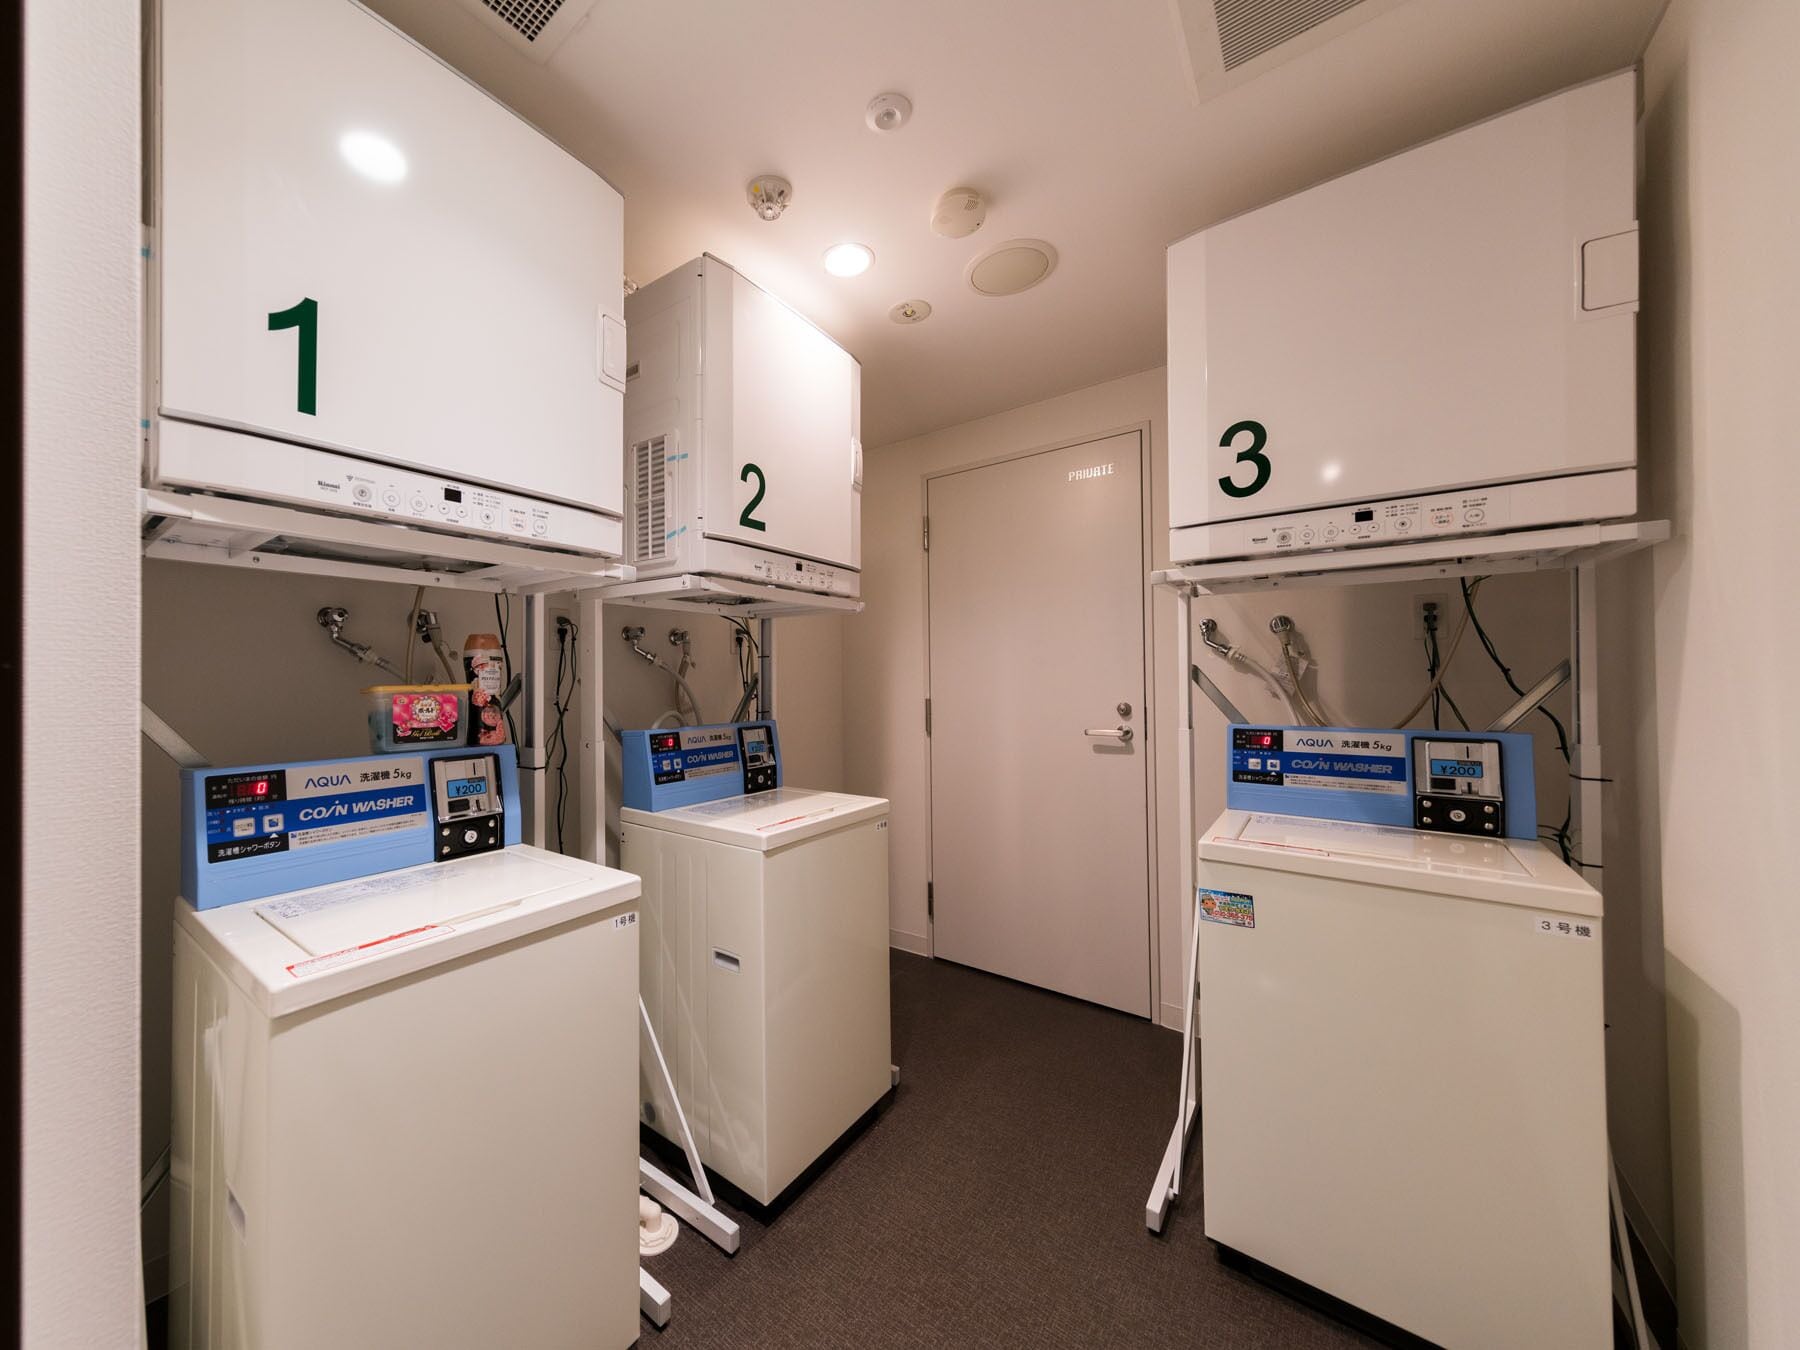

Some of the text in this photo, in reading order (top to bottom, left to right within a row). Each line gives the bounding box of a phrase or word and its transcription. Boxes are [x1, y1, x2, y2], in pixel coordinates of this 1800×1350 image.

[268, 297, 318, 417] 1
[1218, 420, 1272, 498] 3
[1068, 463, 1115, 482] PRIVATE
[739, 463, 766, 532] 2
[668, 738, 674, 747] 0
[688, 736, 706, 744] AQUA
[1263, 736, 1271, 745] 0
[1296, 738, 1392, 751] AQUA 洗濯機 5kg
[707, 750, 734, 760] WASHER
[1291, 758, 1393, 774] COIN WASHER
[1440, 765, 1476, 776] ¥200
[304, 768, 412, 790] AQUA 洗濯機 5kg
[257, 781, 266, 794] 0
[455, 783, 482, 796] ¥200
[299, 795, 414, 821] COIN WASHER
[217, 841, 281, 857] 洗濯機シャワーボタン
